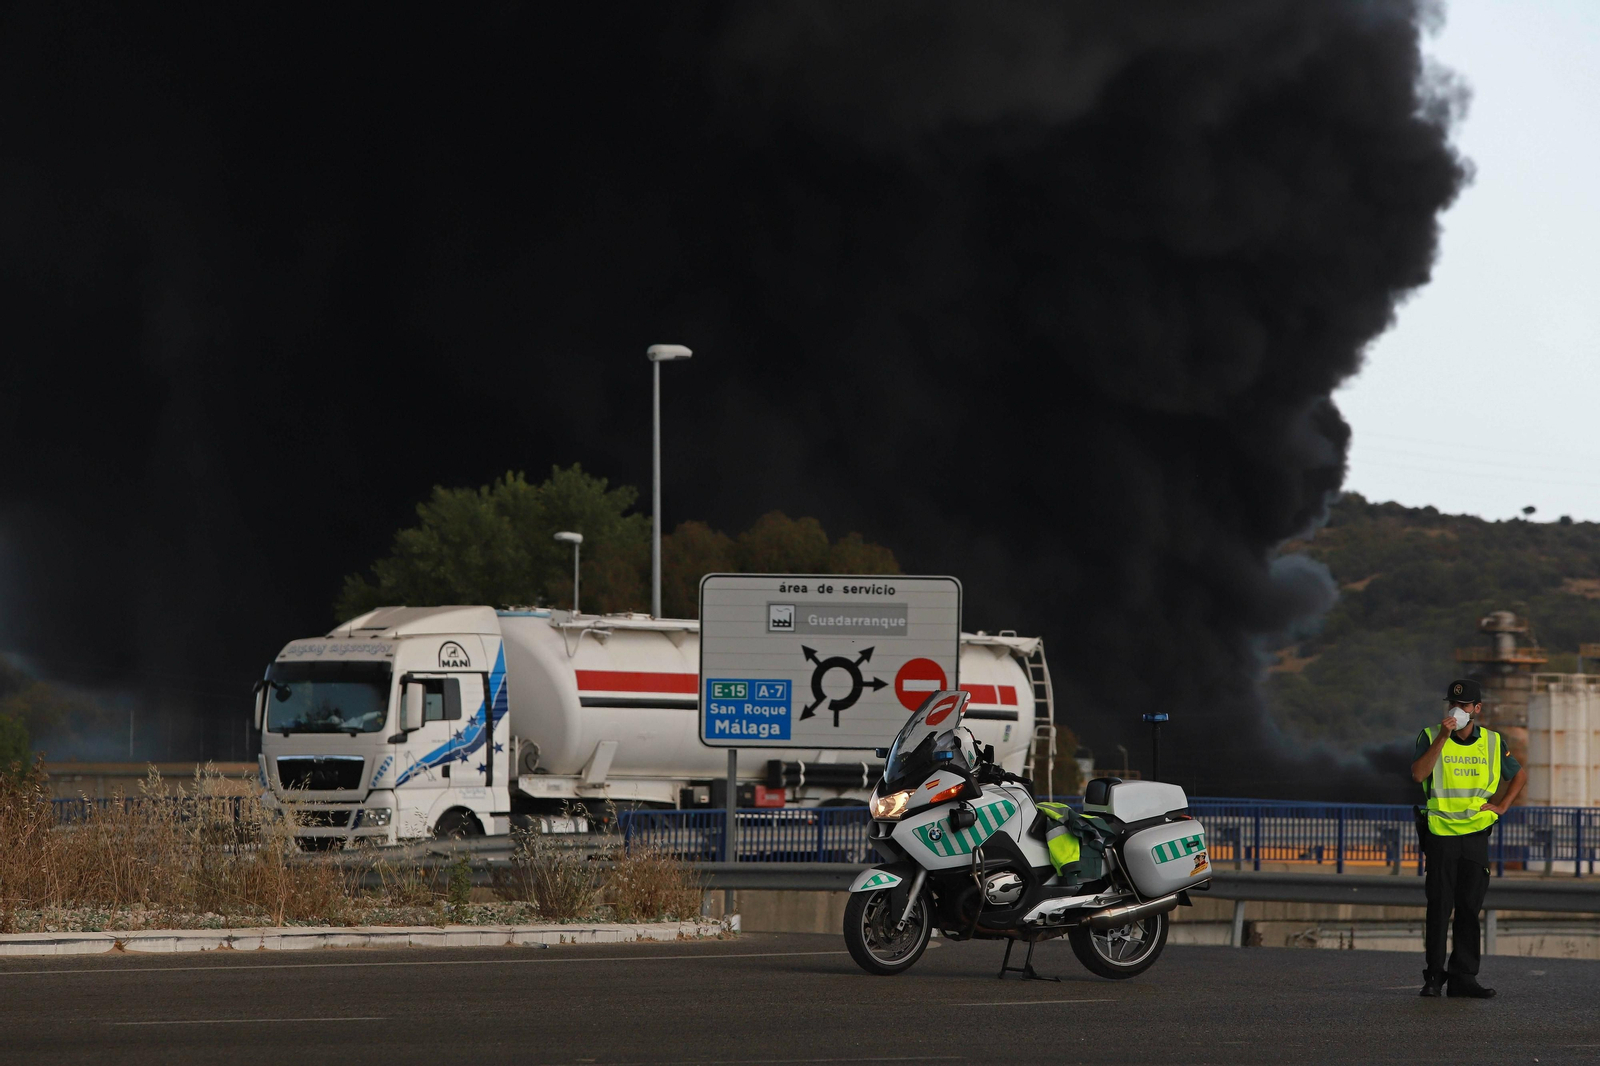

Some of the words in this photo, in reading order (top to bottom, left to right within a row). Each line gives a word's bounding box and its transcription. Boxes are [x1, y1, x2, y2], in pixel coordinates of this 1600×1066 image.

[779, 582, 808, 594] área
[818, 584, 834, 594] de
[843, 584, 896, 596] servicio
[808, 614, 906, 629] Guadarranque
[442, 660, 467, 668] MAN
[714, 685, 745, 697] E-15
[758, 685, 784, 697] A-7
[710, 703, 736, 714] San
[744, 703, 786, 717] Roque
[715, 719, 780, 738] Málaga
[1444, 756, 1487, 765] GUARDIA
